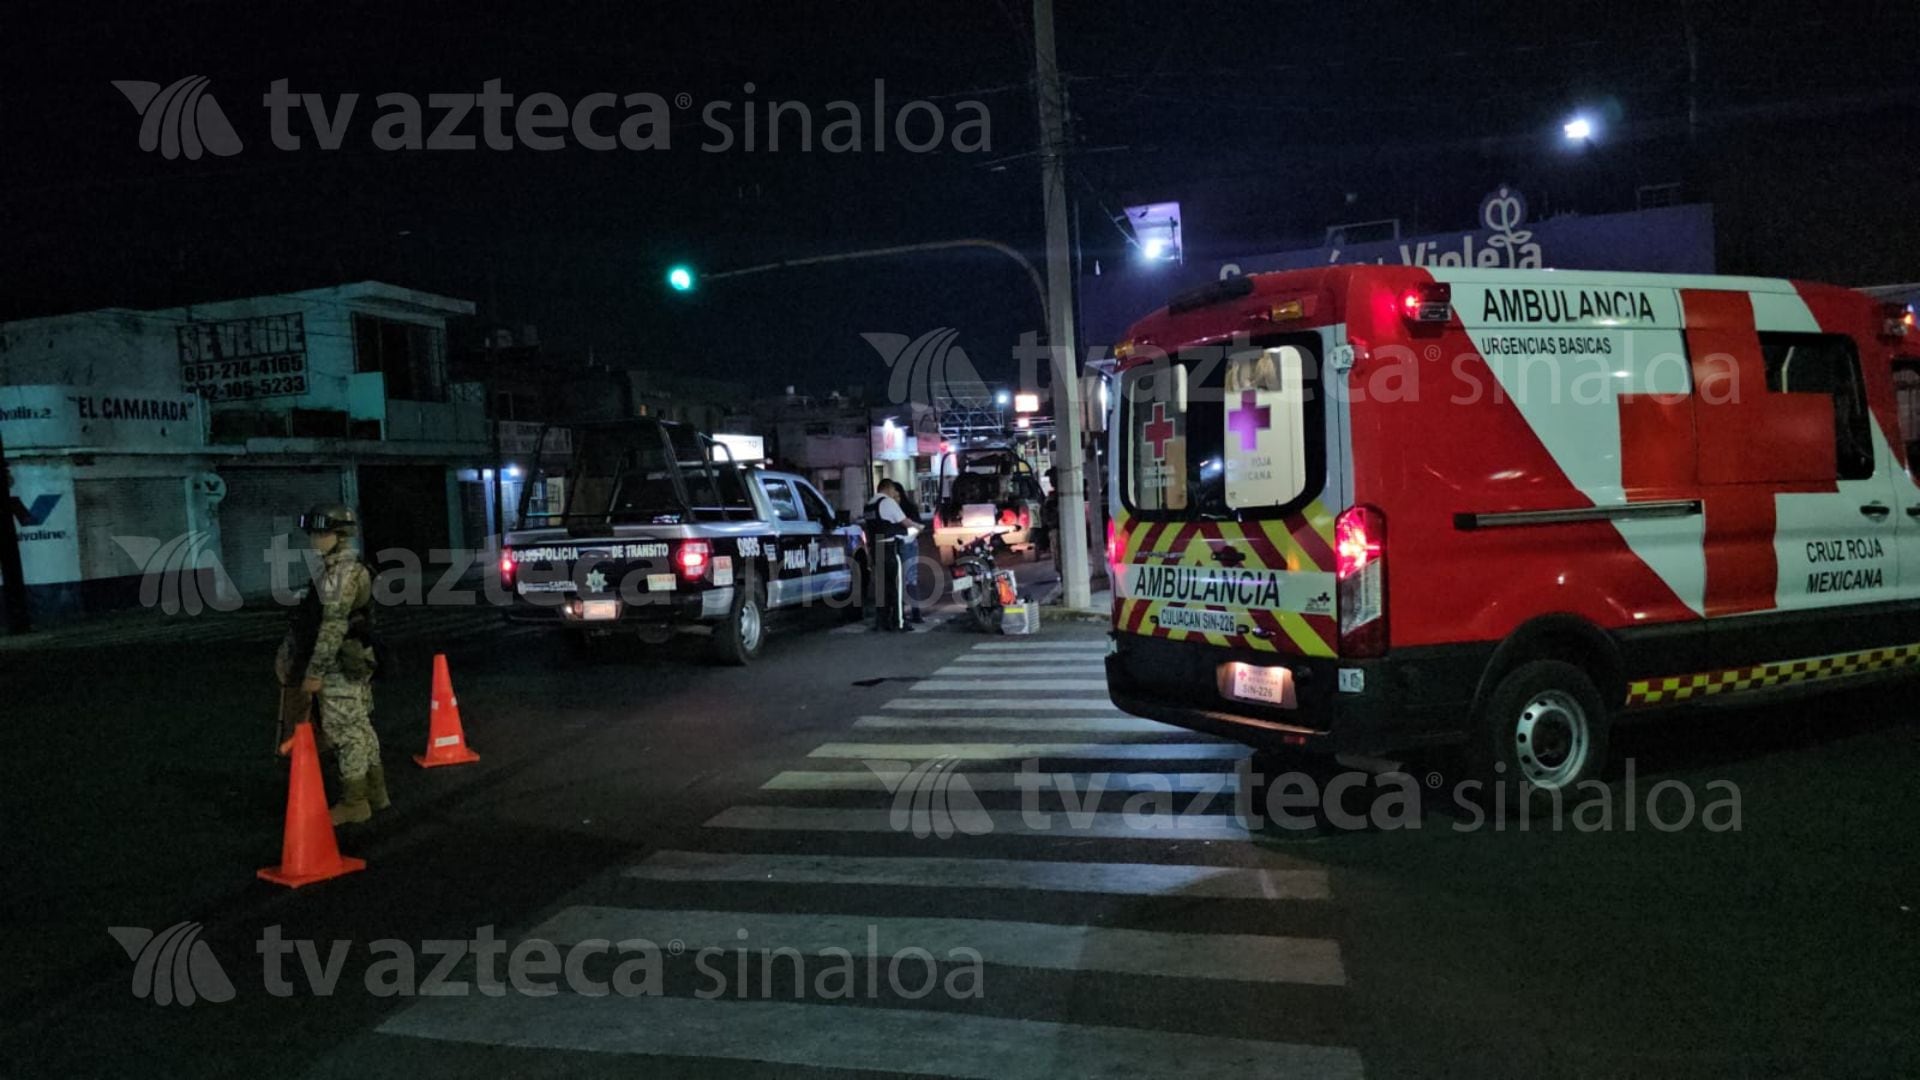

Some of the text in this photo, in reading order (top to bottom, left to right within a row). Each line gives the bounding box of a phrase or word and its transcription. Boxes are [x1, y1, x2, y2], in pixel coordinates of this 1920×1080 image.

[1483, 288, 1656, 323] AMBULANCIA
[1482, 337, 1612, 355] URGENCIAS BASICAS
[538, 547, 579, 561] POLICIA
[612, 548, 624, 559] DE
[626, 544, 669, 558] TRANSITO
[1806, 538, 1884, 562] CRUZ ROJA
[1134, 567, 1280, 607] AMBULANCIA
[1806, 568, 1884, 593] MEXICANA
[1161, 608, 1235, 632] CULIACAN SIN-226
